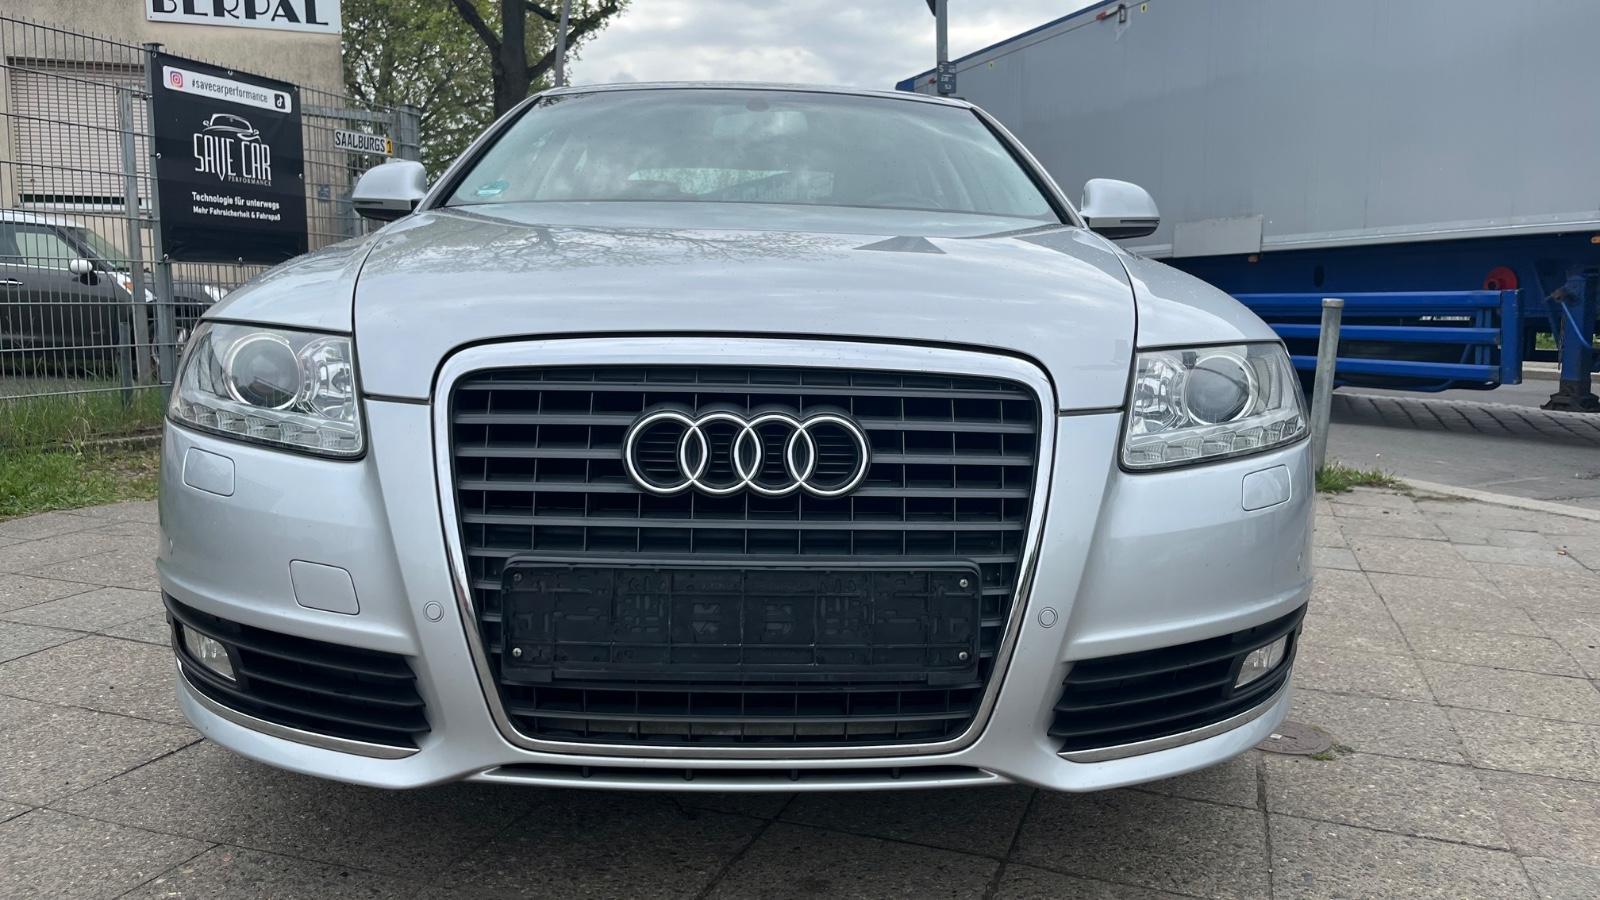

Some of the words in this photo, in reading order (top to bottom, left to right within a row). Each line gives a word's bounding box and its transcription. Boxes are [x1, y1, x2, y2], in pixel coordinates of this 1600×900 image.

[191, 79, 268, 103] #savecarperformance
[335, 131, 386, 153] SAALBURGS
[193, 133, 237, 181] SAVE
[241, 141, 272, 181] CAR
[191, 191, 233, 206] Technologie
[234, 196, 245, 206] für
[245, 198, 280, 211] unterwegs
[193, 206, 209, 215] Mehr
[209, 207, 250, 219] Fahrsicherheit
[250, 211, 256, 219] &
[256, 211, 281, 221] Fahrspaß
